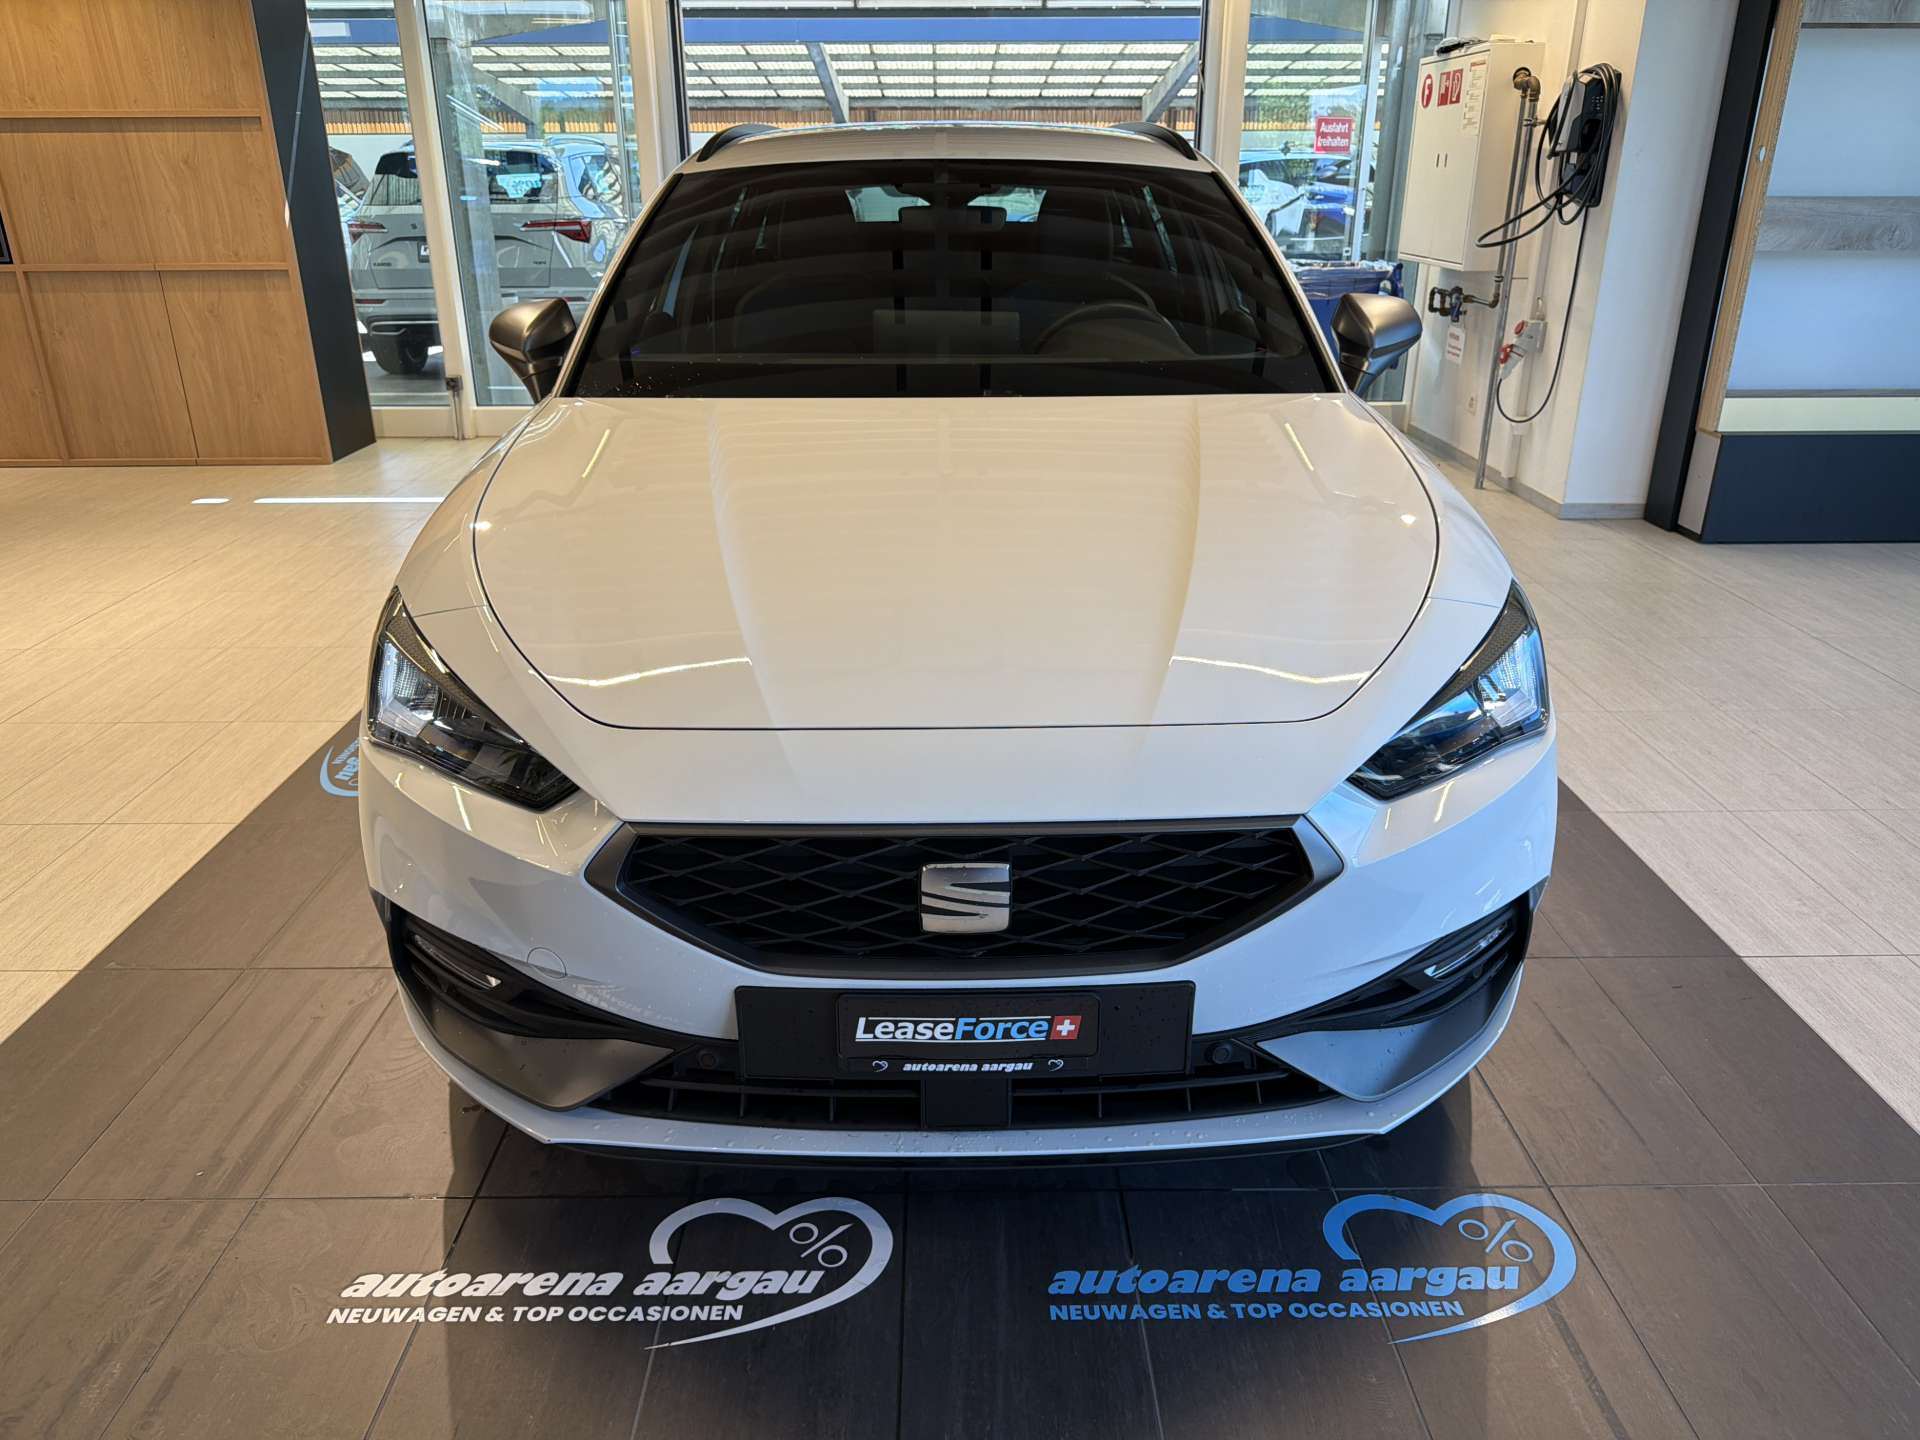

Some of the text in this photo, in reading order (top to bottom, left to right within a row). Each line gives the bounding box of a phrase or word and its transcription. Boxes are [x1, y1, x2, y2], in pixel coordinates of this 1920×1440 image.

[1319, 121, 1349, 133] Ausfahrt
[855, 1017, 1049, 1040] LeaseForce
[902, 1060, 1034, 1072] autoarena aargau
[339, 1266, 826, 1301] autoarena aargau
[1047, 1263, 1520, 1297] autoarena aargau
[326, 1302, 744, 1325] NEUWAGEN & TOP OCCASIONEN
[1049, 1300, 1465, 1321] NEUWAGEN & TOP OCCASIONEN
